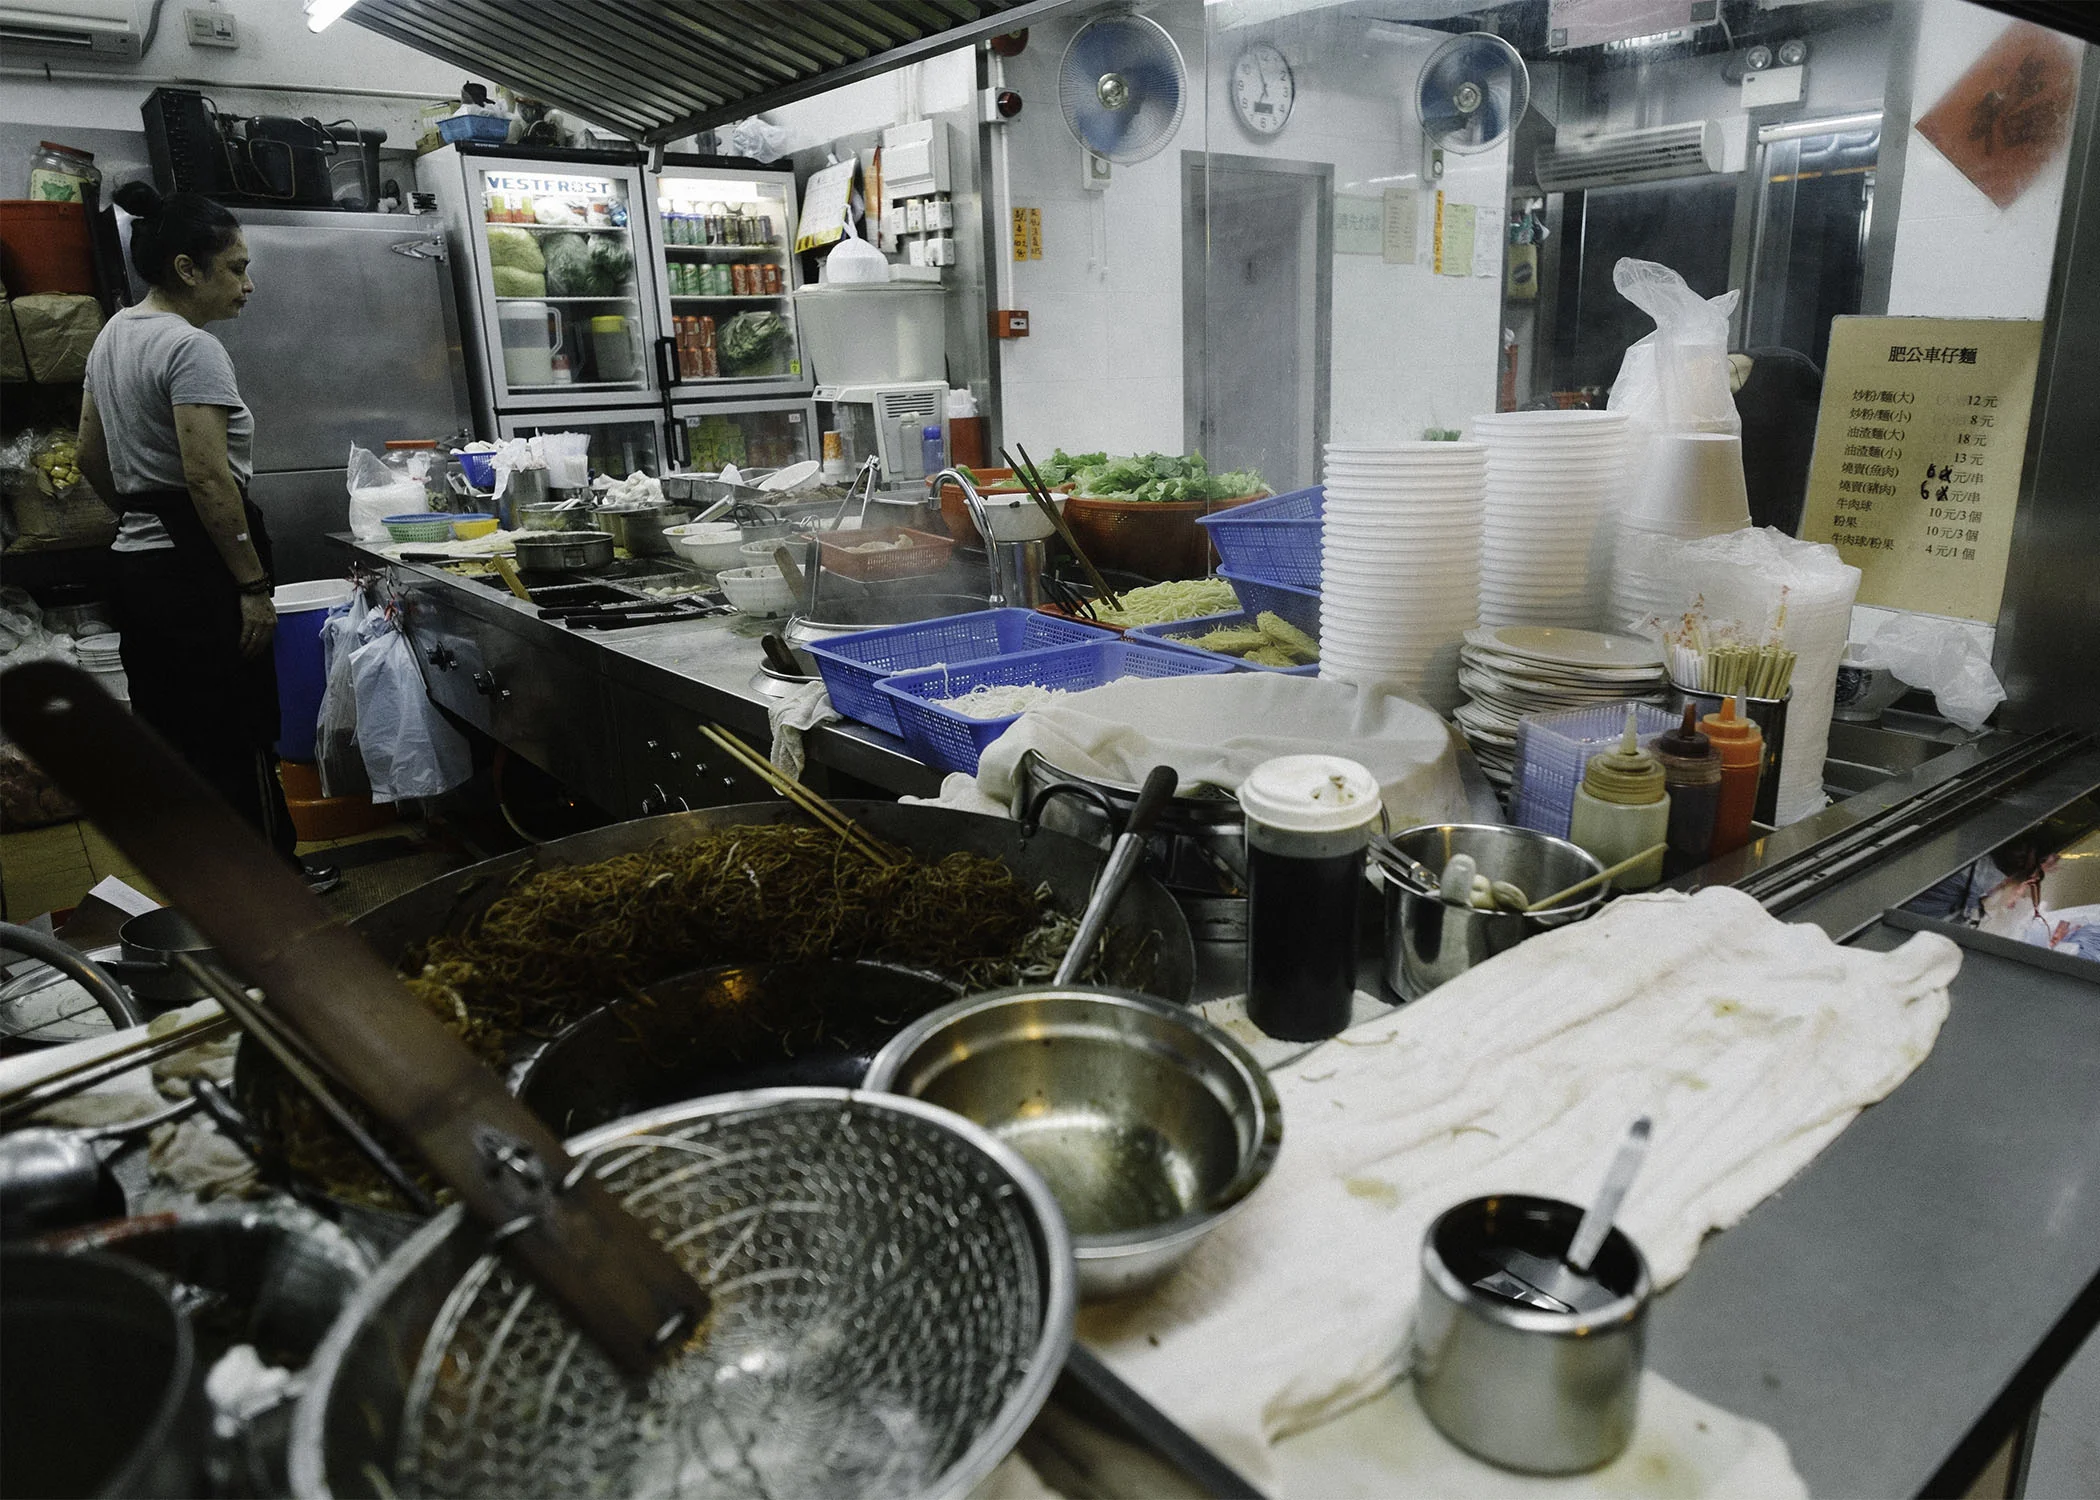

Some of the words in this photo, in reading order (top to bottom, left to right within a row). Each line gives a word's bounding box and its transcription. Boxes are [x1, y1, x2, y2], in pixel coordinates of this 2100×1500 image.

[487, 176, 609, 194] VESTFROST
[1888, 346, 1978, 364] 肥公車仔麵
[1968, 395, 1981, 406] 12
[1957, 433, 1971, 444] 18
[1954, 452, 1967, 463] 13
[1836, 497, 1873, 512] 牛肉球
[1833, 515, 1858, 528] 粉果
